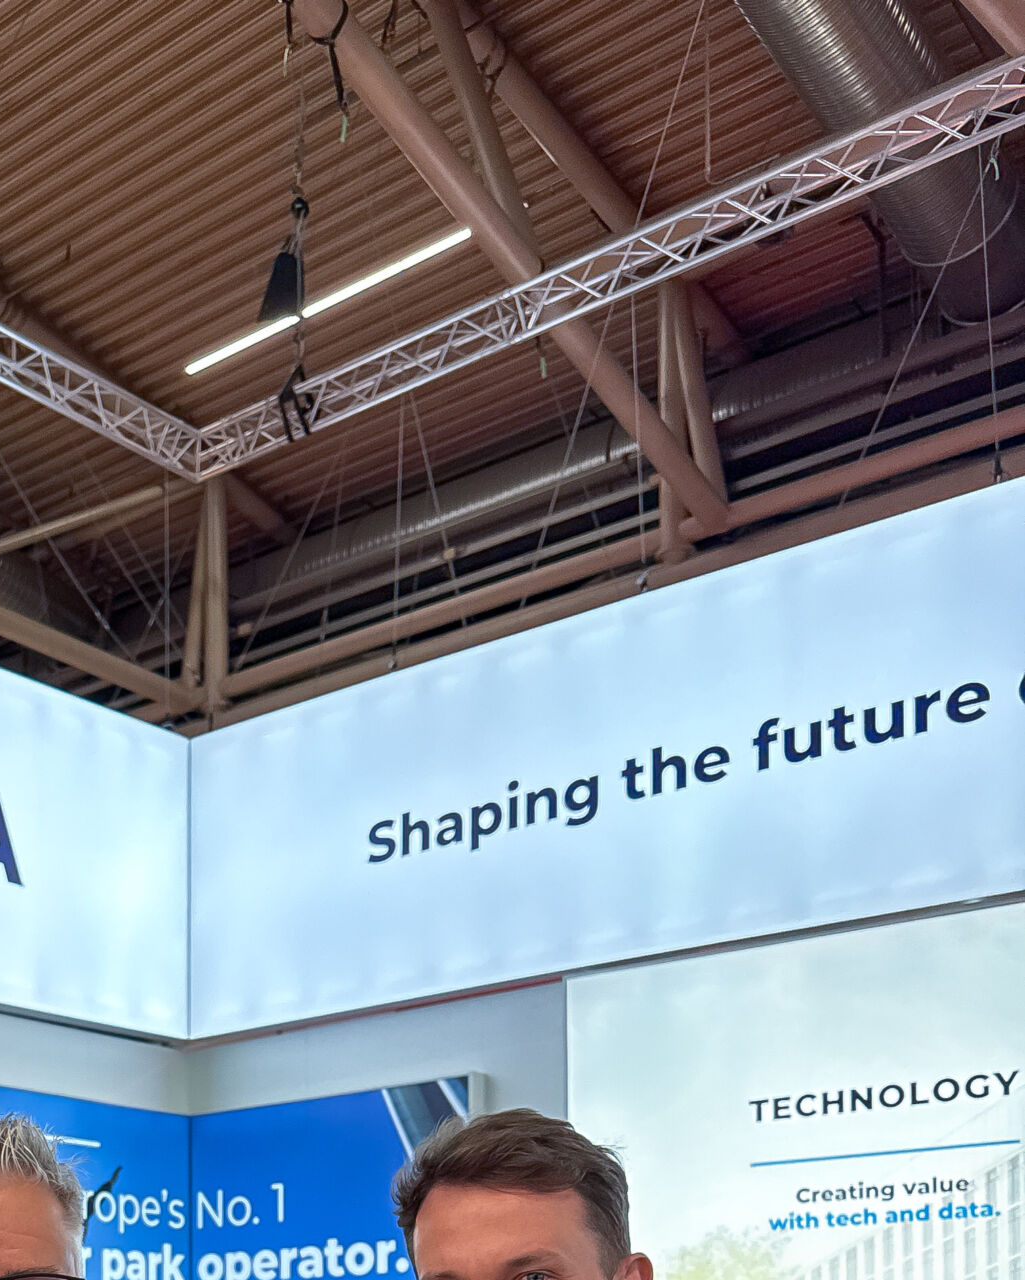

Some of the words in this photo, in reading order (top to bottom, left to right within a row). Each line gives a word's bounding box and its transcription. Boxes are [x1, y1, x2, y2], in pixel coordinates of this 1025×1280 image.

[367, 774, 599, 864] Shaping
[621, 747, 730, 799] the
[752, 681, 991, 771] future
[749, 1070, 1019, 1122] TECHNOLOGY
[196, 1188, 261, 1230] No.
[271, 1182, 285, 1223] 1
[796, 1181, 895, 1203] Creating
[902, 1177, 970, 1195] value
[769, 1212, 819, 1231] with
[827, 1208, 877, 1228] tech
[886, 1204, 930, 1224] and
[938, 1202, 1001, 1220] data.
